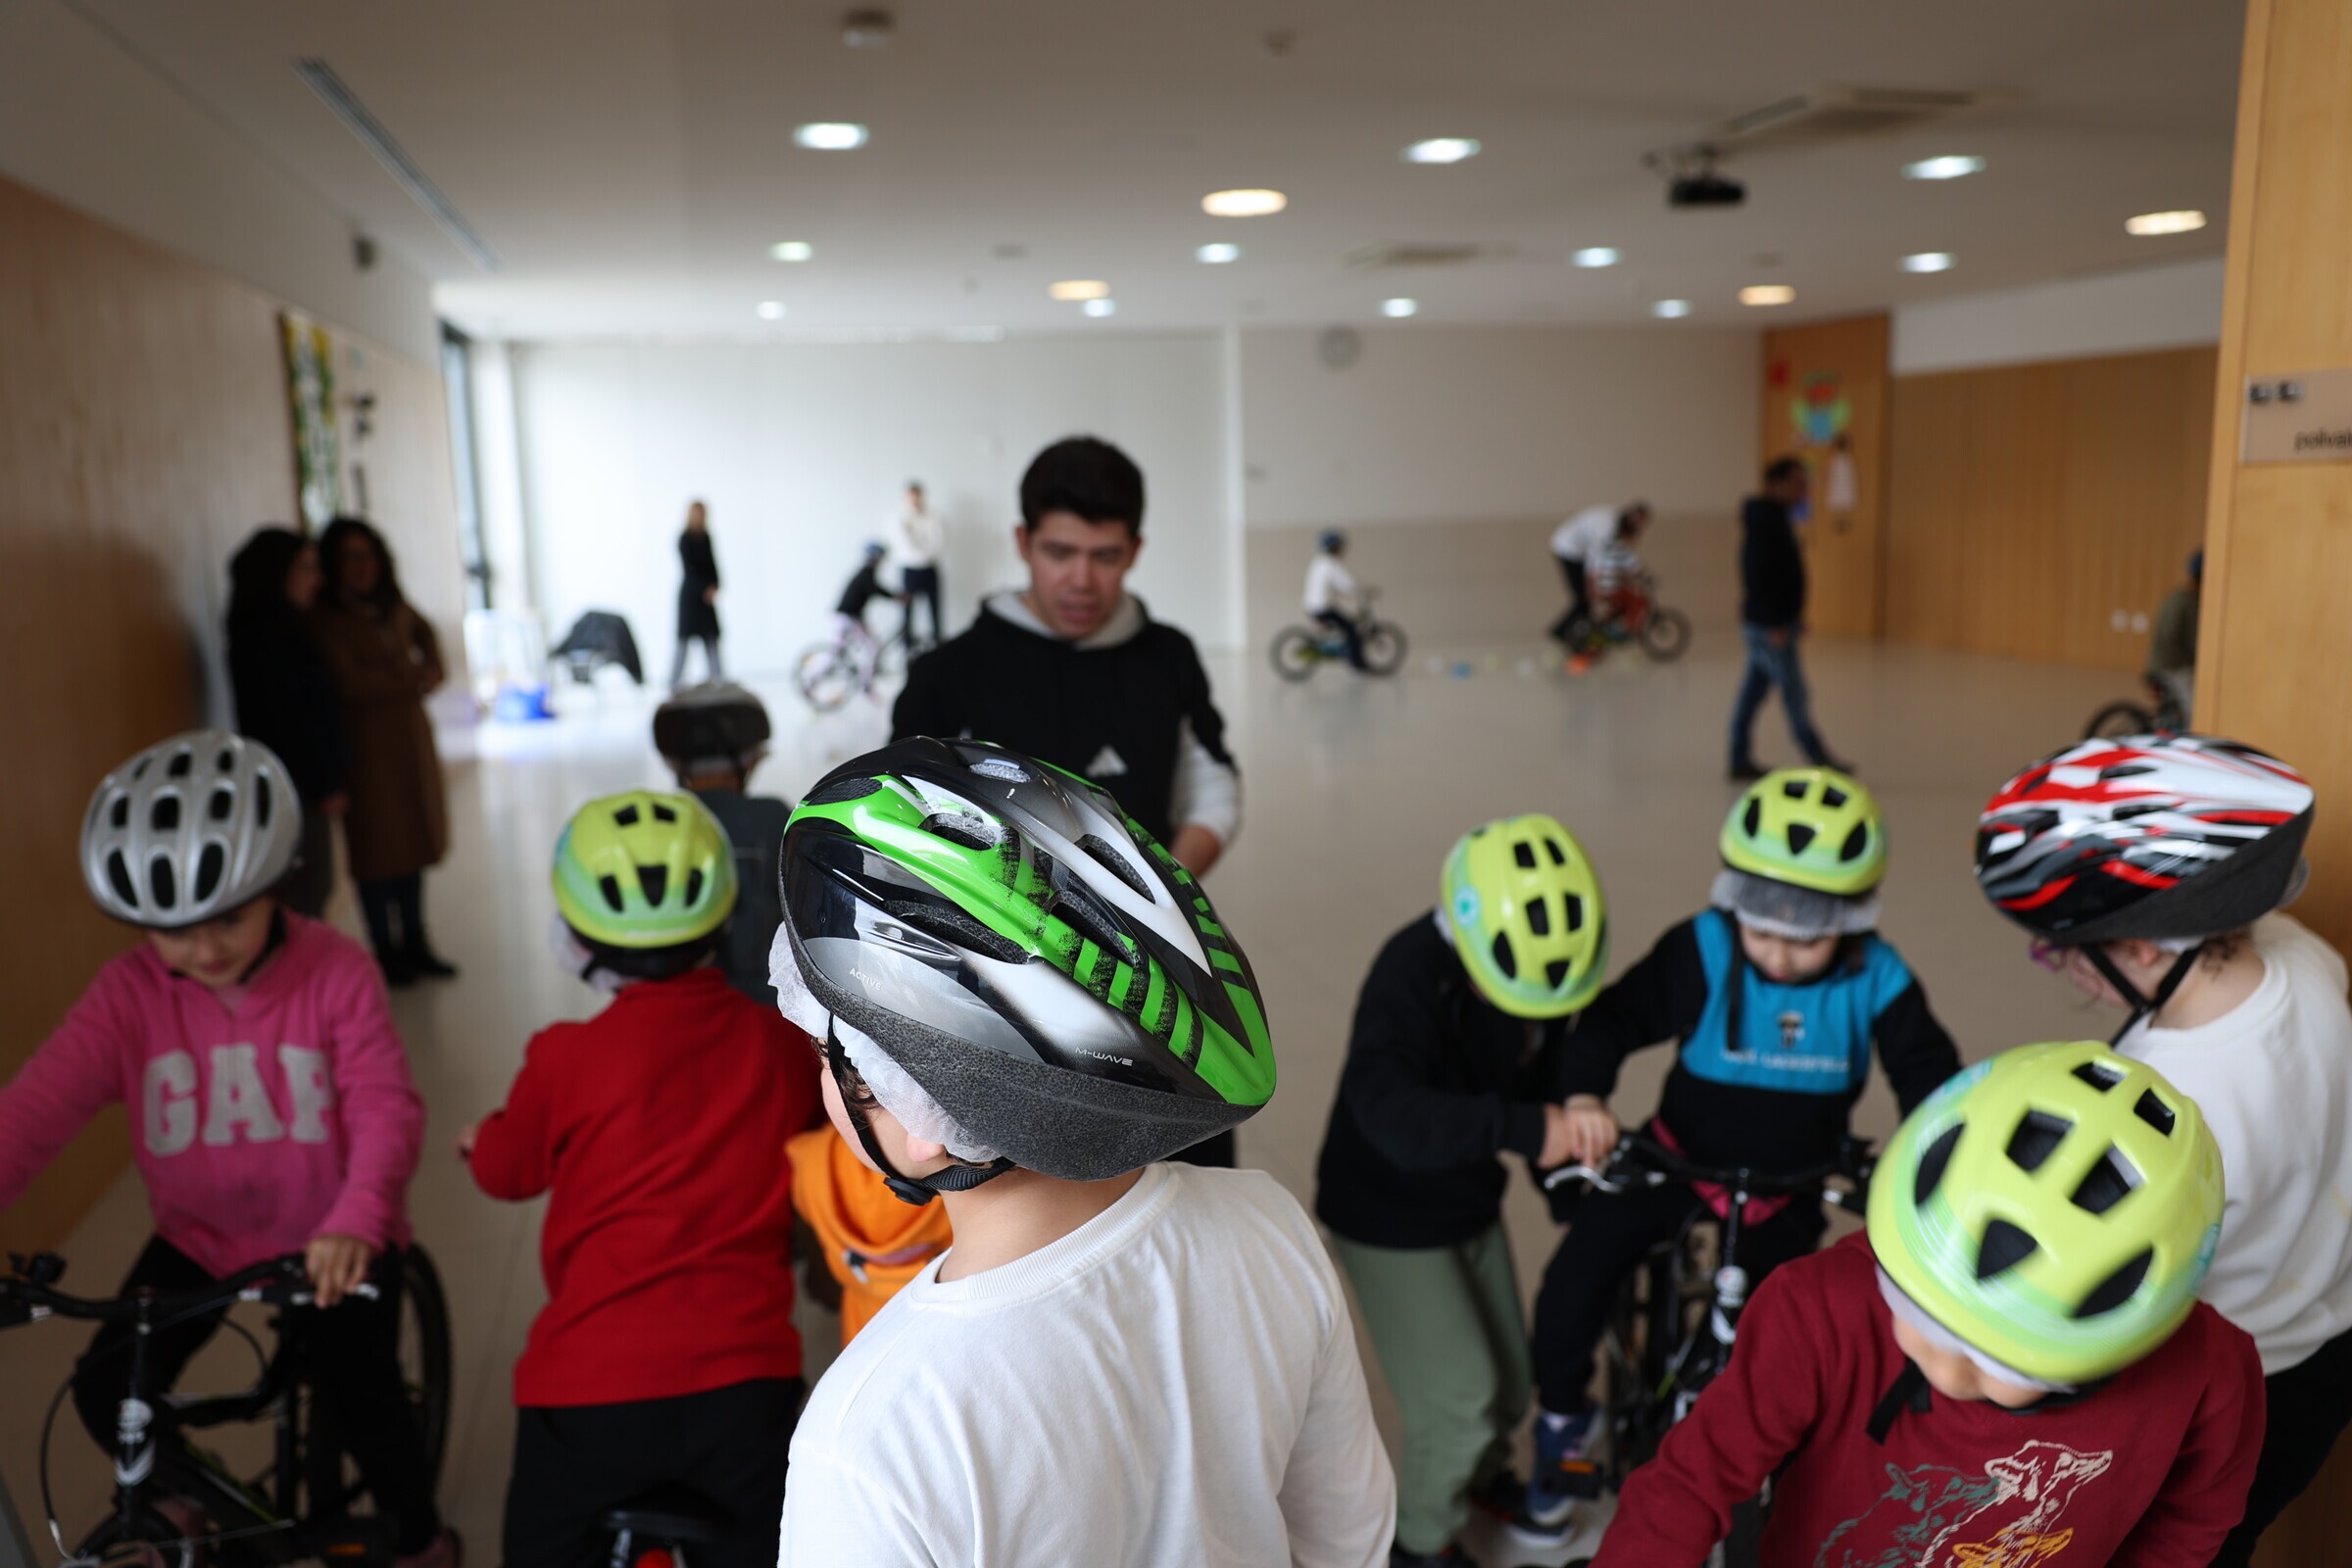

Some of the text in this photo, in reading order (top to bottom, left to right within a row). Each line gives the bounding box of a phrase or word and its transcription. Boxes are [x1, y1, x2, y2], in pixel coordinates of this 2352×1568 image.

[849, 967, 882, 991] ACTIVE
[1075, 1047, 1133, 1066] M-WAVE
[144, 1043, 335, 1157] GAP
